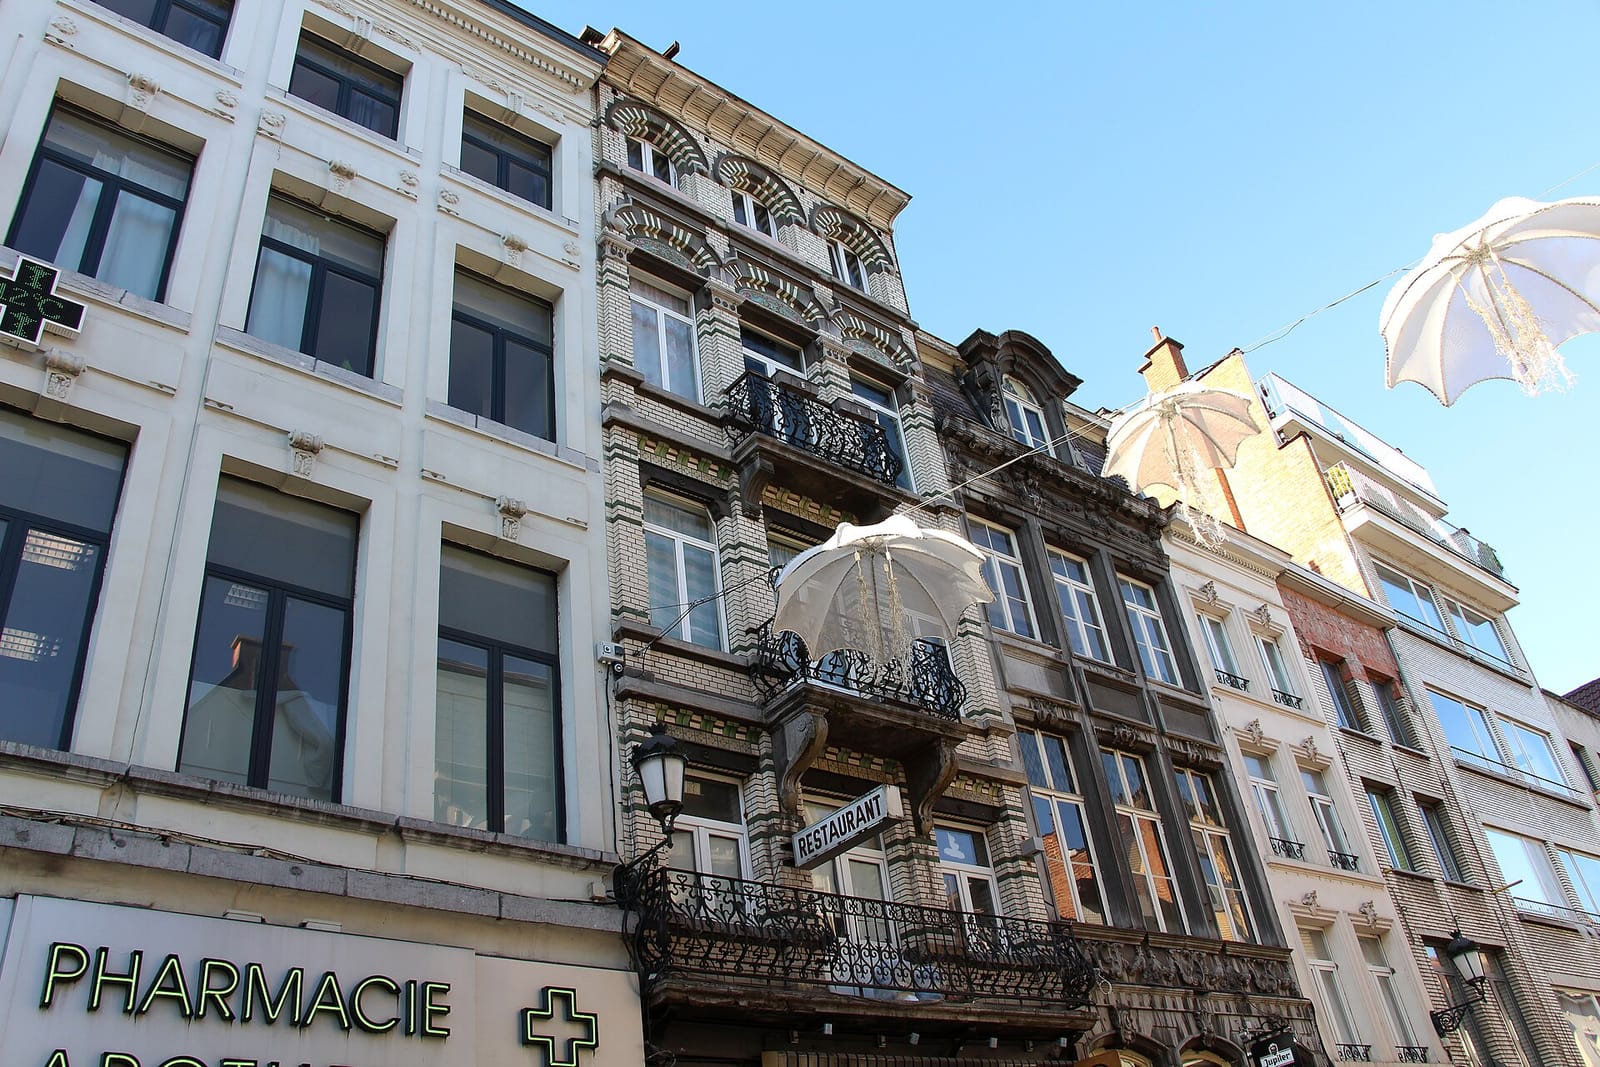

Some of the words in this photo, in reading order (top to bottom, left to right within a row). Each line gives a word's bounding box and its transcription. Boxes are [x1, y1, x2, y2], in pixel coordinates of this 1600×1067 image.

[798, 794, 881, 859] RESTAURANT
[40, 941, 451, 1038] PHARMACIE
[1264, 1052, 1290, 1067] Jupiler
